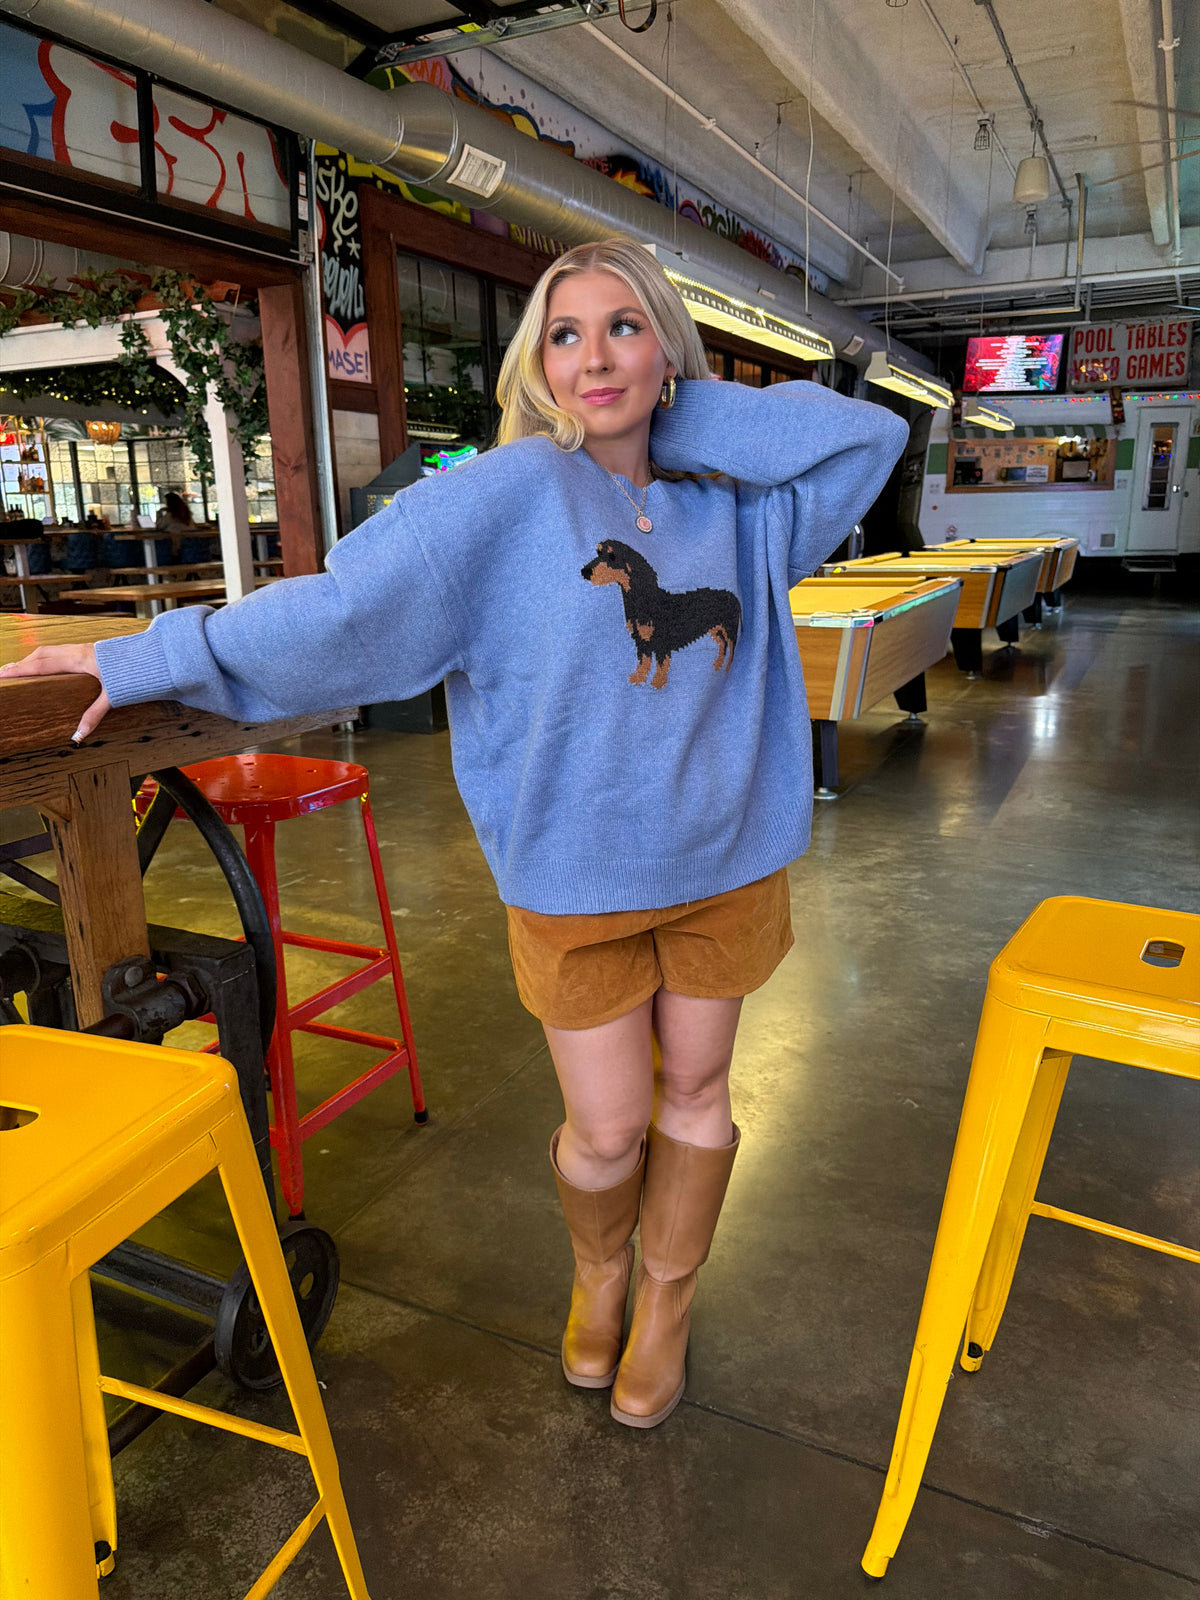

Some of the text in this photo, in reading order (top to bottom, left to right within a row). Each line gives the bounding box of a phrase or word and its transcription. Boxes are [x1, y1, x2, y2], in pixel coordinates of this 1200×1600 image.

[1074, 322, 1188, 354] POOL TABLES
[1126, 351, 1186, 380] GAMES
